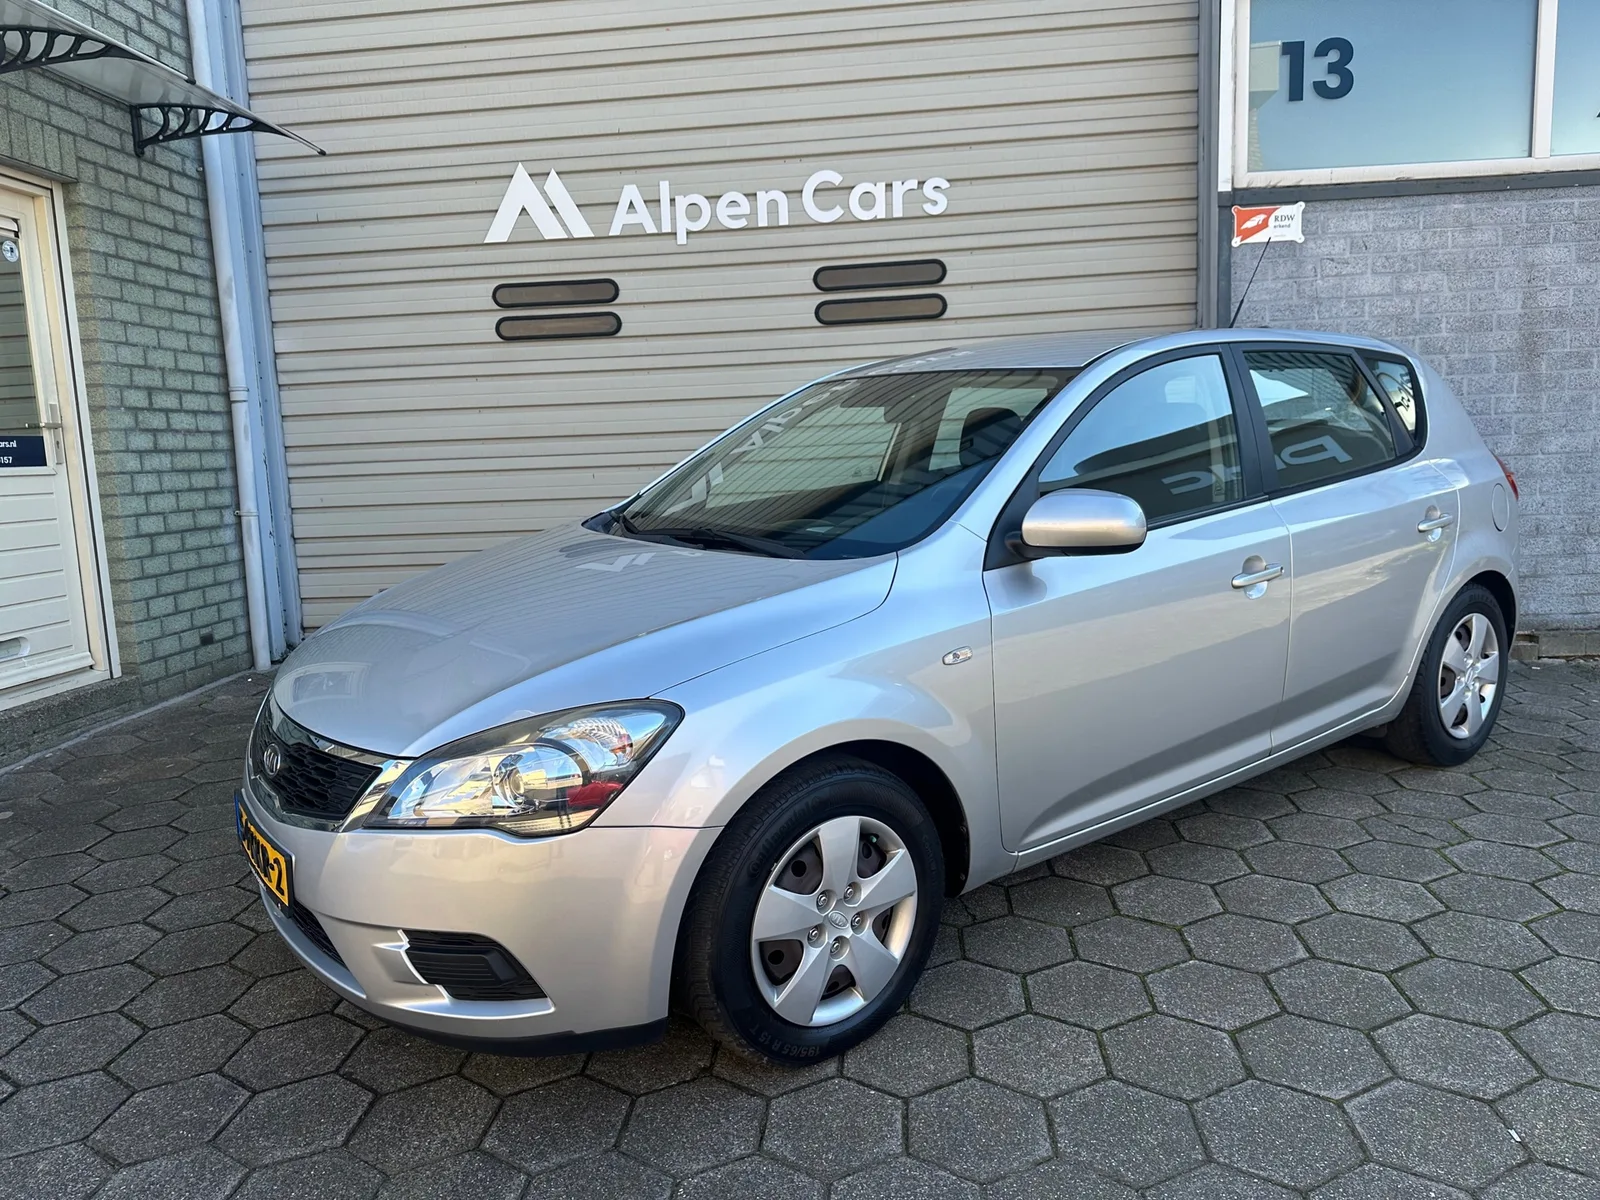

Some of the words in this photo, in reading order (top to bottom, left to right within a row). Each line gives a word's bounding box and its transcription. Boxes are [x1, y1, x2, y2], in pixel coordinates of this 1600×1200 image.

[1281, 36, 1354, 102] 13
[608, 180, 789, 245] Alpen
[802, 169, 951, 224] Cars
[1274, 214, 1296, 222] RDW
[758, 1031, 772, 1044] 15
[771, 1039, 782, 1051] R
[781, 1044, 820, 1057] 195/65
